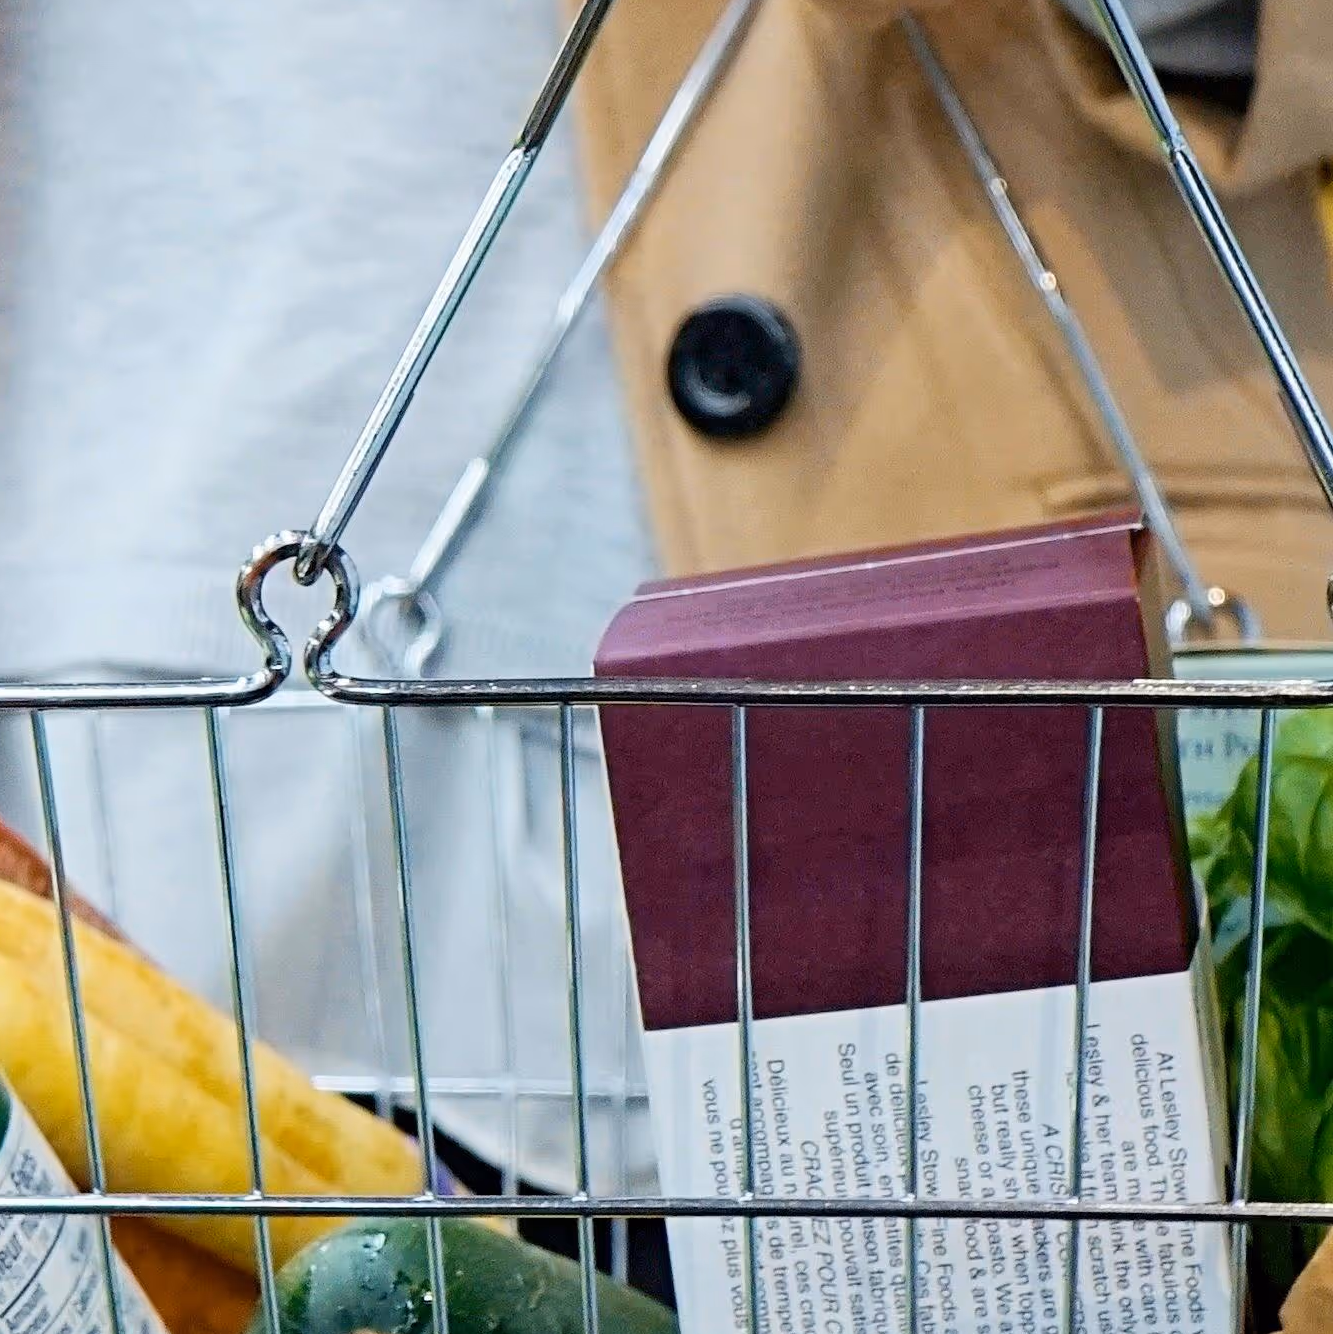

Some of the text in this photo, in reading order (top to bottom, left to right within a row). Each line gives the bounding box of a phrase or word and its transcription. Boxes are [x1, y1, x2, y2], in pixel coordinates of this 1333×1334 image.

[837, 1041, 860, 1087] Seul
[884, 1051, 903, 1077] de
[1130, 1032, 1155, 1120] delicious
[1155, 1049, 1175, 1073] At
[766, 1058, 792, 1147] Délicieux
[844, 1091, 860, 1116] un
[864, 1070, 884, 1118] avec
[967, 1083, 990, 1156] cheese
[990, 1083, 1011, 1115] but
[1011, 1069, 1032, 1124] these
[1091, 1093, 1111, 1108] &
[1159, 1077, 1182, 1142] Lesley
[821, 1109, 849, 1201] supérieu
[843, 1121, 873, 1188] produit
[871, 1122, 892, 1170] soin,
[995, 1119, 1018, 1173] really
[1040, 1121, 1060, 1138] A
[1094, 1113, 1113, 1145] her
[1120, 1139, 1138, 1173] are
[1142, 1123, 1164, 1172] food.
[749, 1096, 780, 1230] accompags
[768, 1235, 787, 1260] de
[779, 1151, 796, 1177] au
[878, 1173, 894, 1198] en
[954, 1155, 973, 1199] snac
[977, 1160, 993, 1181] or
[1018, 1129, 1041, 1196] unique
[1043, 1143, 1066, 1198] CRIS
[1099, 1151, 1119, 1204] team
[701, 1077, 748, 1329] vous ne pouz plus vous
[783, 1182, 809, 1254] nrel,
[799, 1139, 831, 1244] CRAEZ
[1125, 1177, 1146, 1232] me
[1148, 1176, 1170, 1237] The
[833, 1216, 864, 1288] pouvait
[857, 1193, 881, 1264] aison
[883, 1214, 905, 1268] etites
[920, 1148, 940, 1198] Stow
[935, 1262, 959, 1322] Foods
[980, 1186, 1007, 1279] apasto.
[1031, 1217, 1054, 1283] ackers
[1107, 1216, 1130, 1254] ink
[793, 1259, 812, 1294] ces
[814, 1249, 840, 1315] POUR
[969, 1265, 988, 1280] &
[1010, 1232, 1032, 1286] when
[1086, 1233, 1113, 1305] scratch
[1113, 1259, 1133, 1290] the
[1133, 1237, 1156, 1278] with
[1157, 1242, 1181, 1324] fabulous
[971, 1285, 989, 1318] are
[993, 1281, 1013, 1316] We
[1040, 1287, 1058, 1319] are
[1139, 1282, 1158, 1326] care
[1183, 1263, 1207, 1324] Foods
